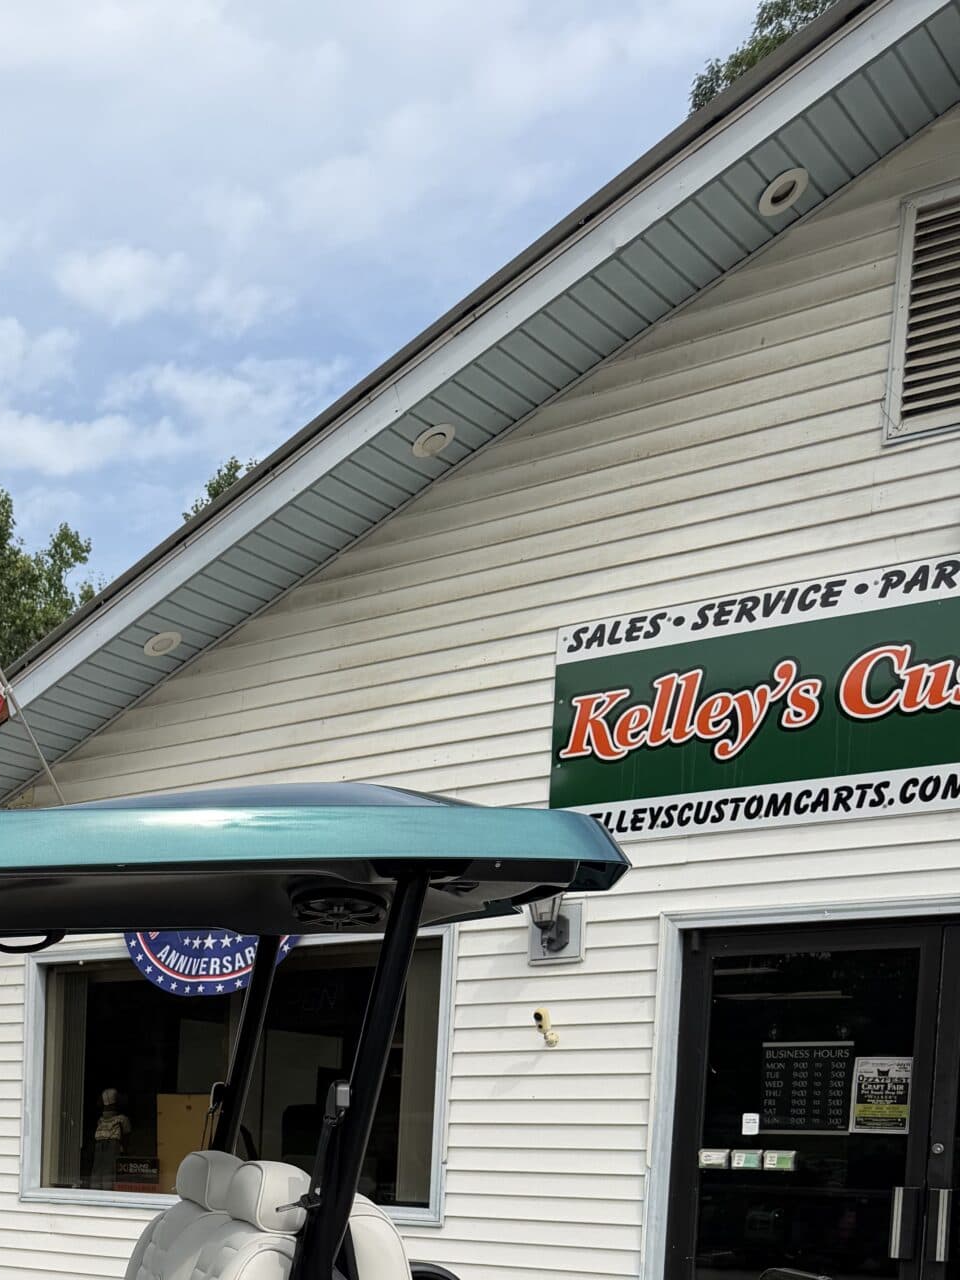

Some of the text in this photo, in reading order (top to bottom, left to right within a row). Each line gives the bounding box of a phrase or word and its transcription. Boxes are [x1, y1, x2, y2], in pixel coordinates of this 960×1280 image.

[566, 559, 960, 653] SALES SERVICE PAR
[559, 644, 960, 761] Kelley's Cu
[765, 1048, 850, 1059] BUSINESS HOURS
[766, 1071, 780, 1079] TUE
[764, 1080, 784, 1088] WED
